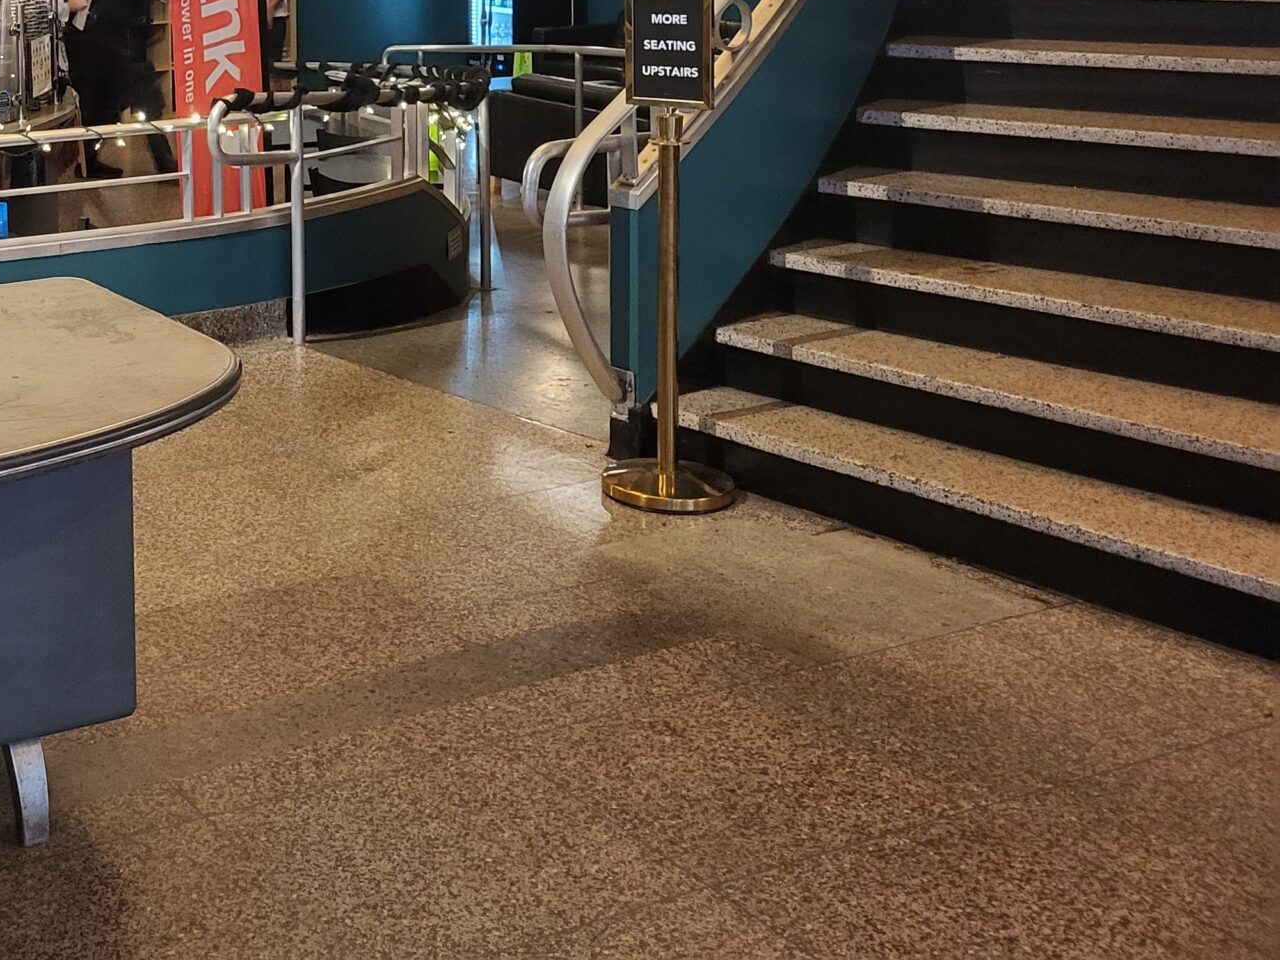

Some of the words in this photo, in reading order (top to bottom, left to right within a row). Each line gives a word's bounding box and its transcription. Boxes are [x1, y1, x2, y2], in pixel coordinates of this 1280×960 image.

[651, 14, 688, 25] MORE
[643, 39, 696, 52] SEATING
[183, 45, 196, 65] in
[642, 65, 699, 78] UPSTAIRS
[184, 72, 195, 103] one
